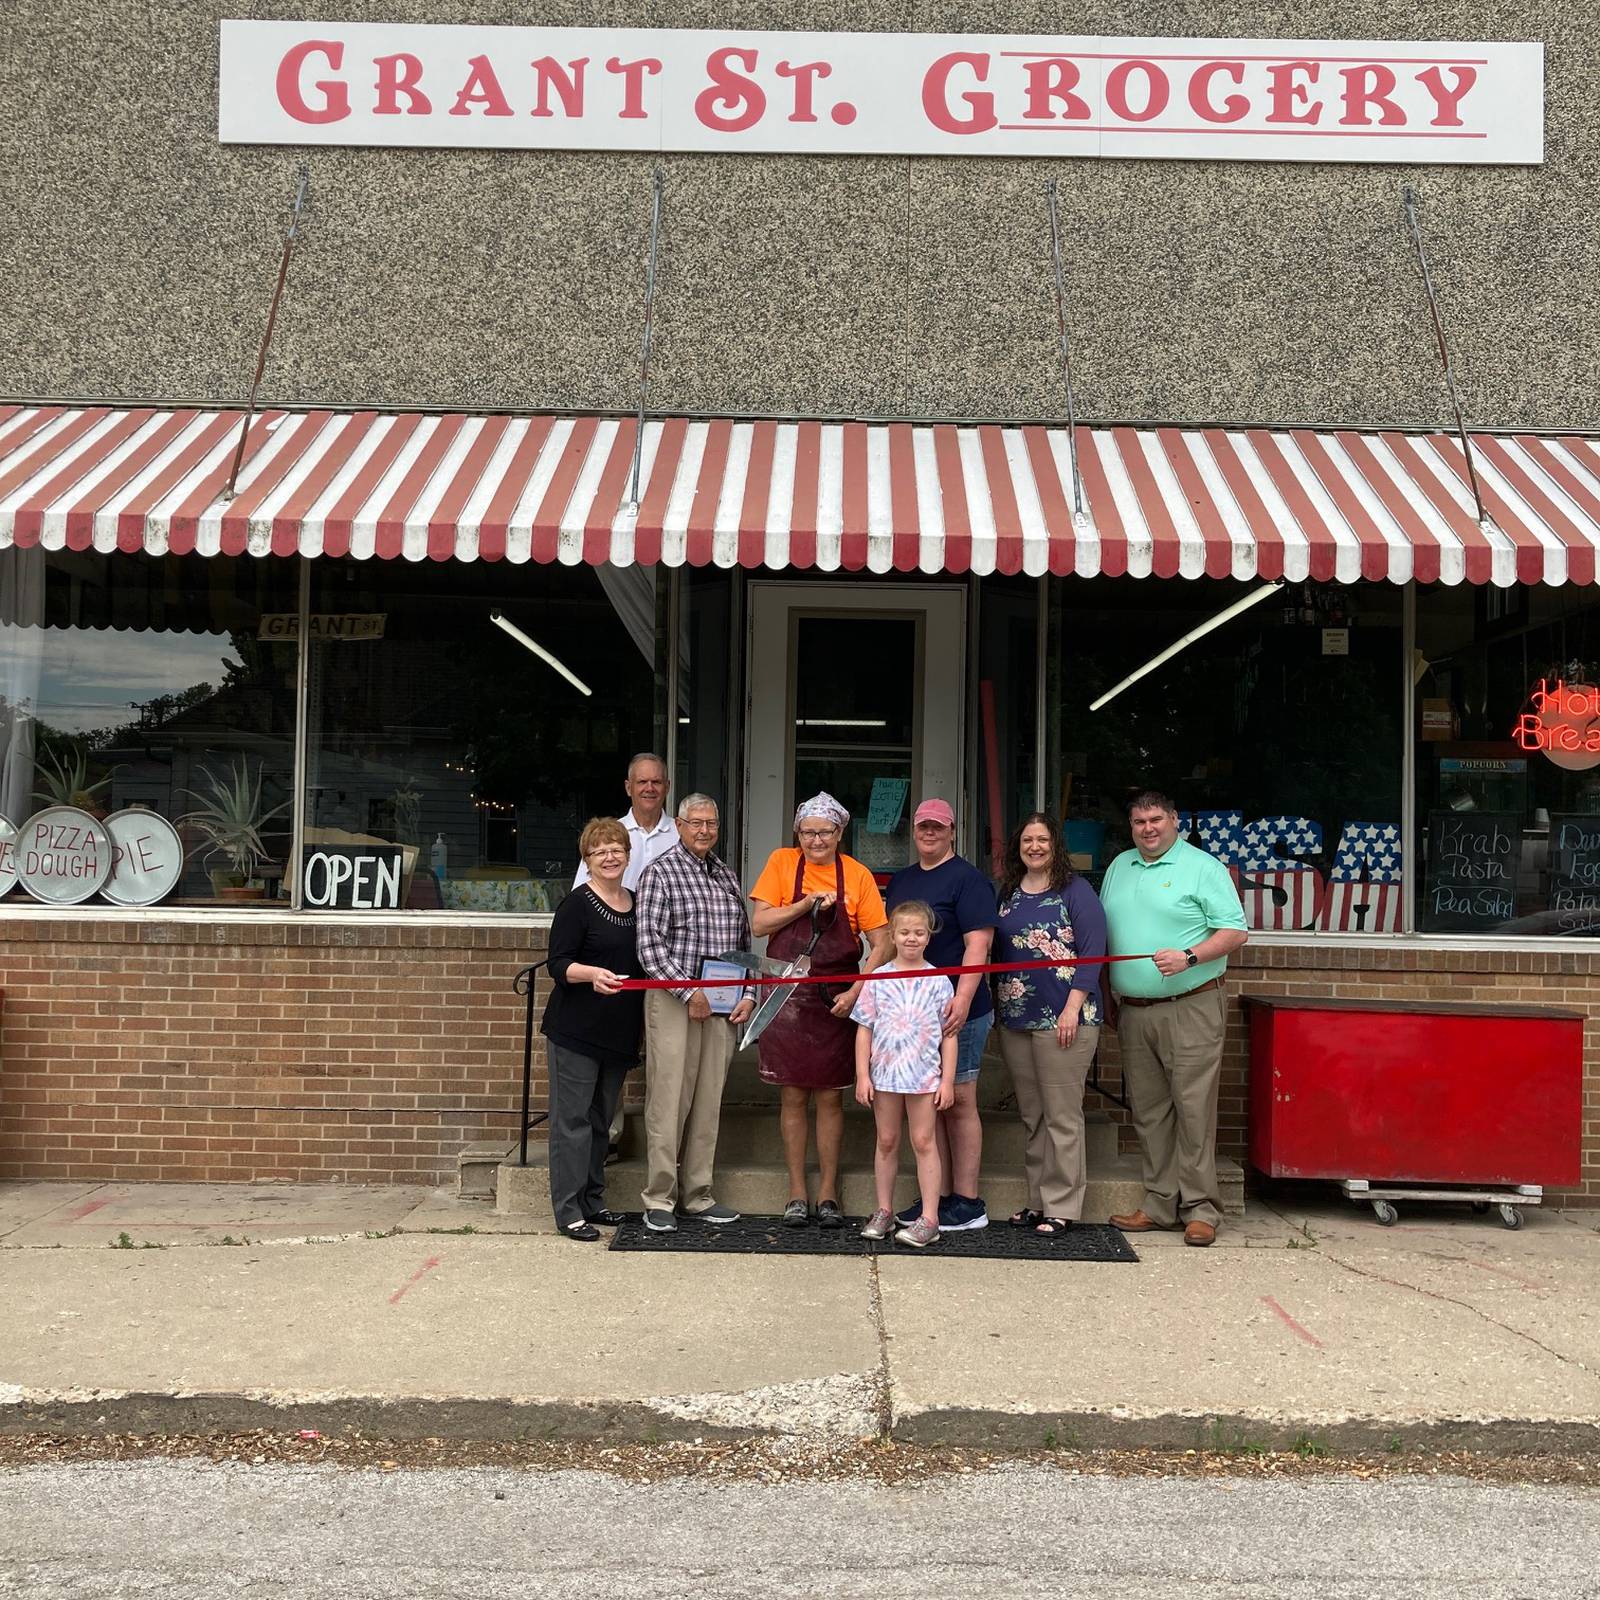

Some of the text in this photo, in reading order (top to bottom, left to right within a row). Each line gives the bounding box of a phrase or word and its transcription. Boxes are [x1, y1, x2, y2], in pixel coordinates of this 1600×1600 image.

[275, 39, 1477, 134] GRANT ST. GROCERY
[35, 823, 97, 852] PIZZA
[26, 851, 97, 878] DOUGH
[111, 836, 164, 880] PIE
[1442, 854, 1511, 879] Pasta
[304, 852, 401, 908] OPEN
